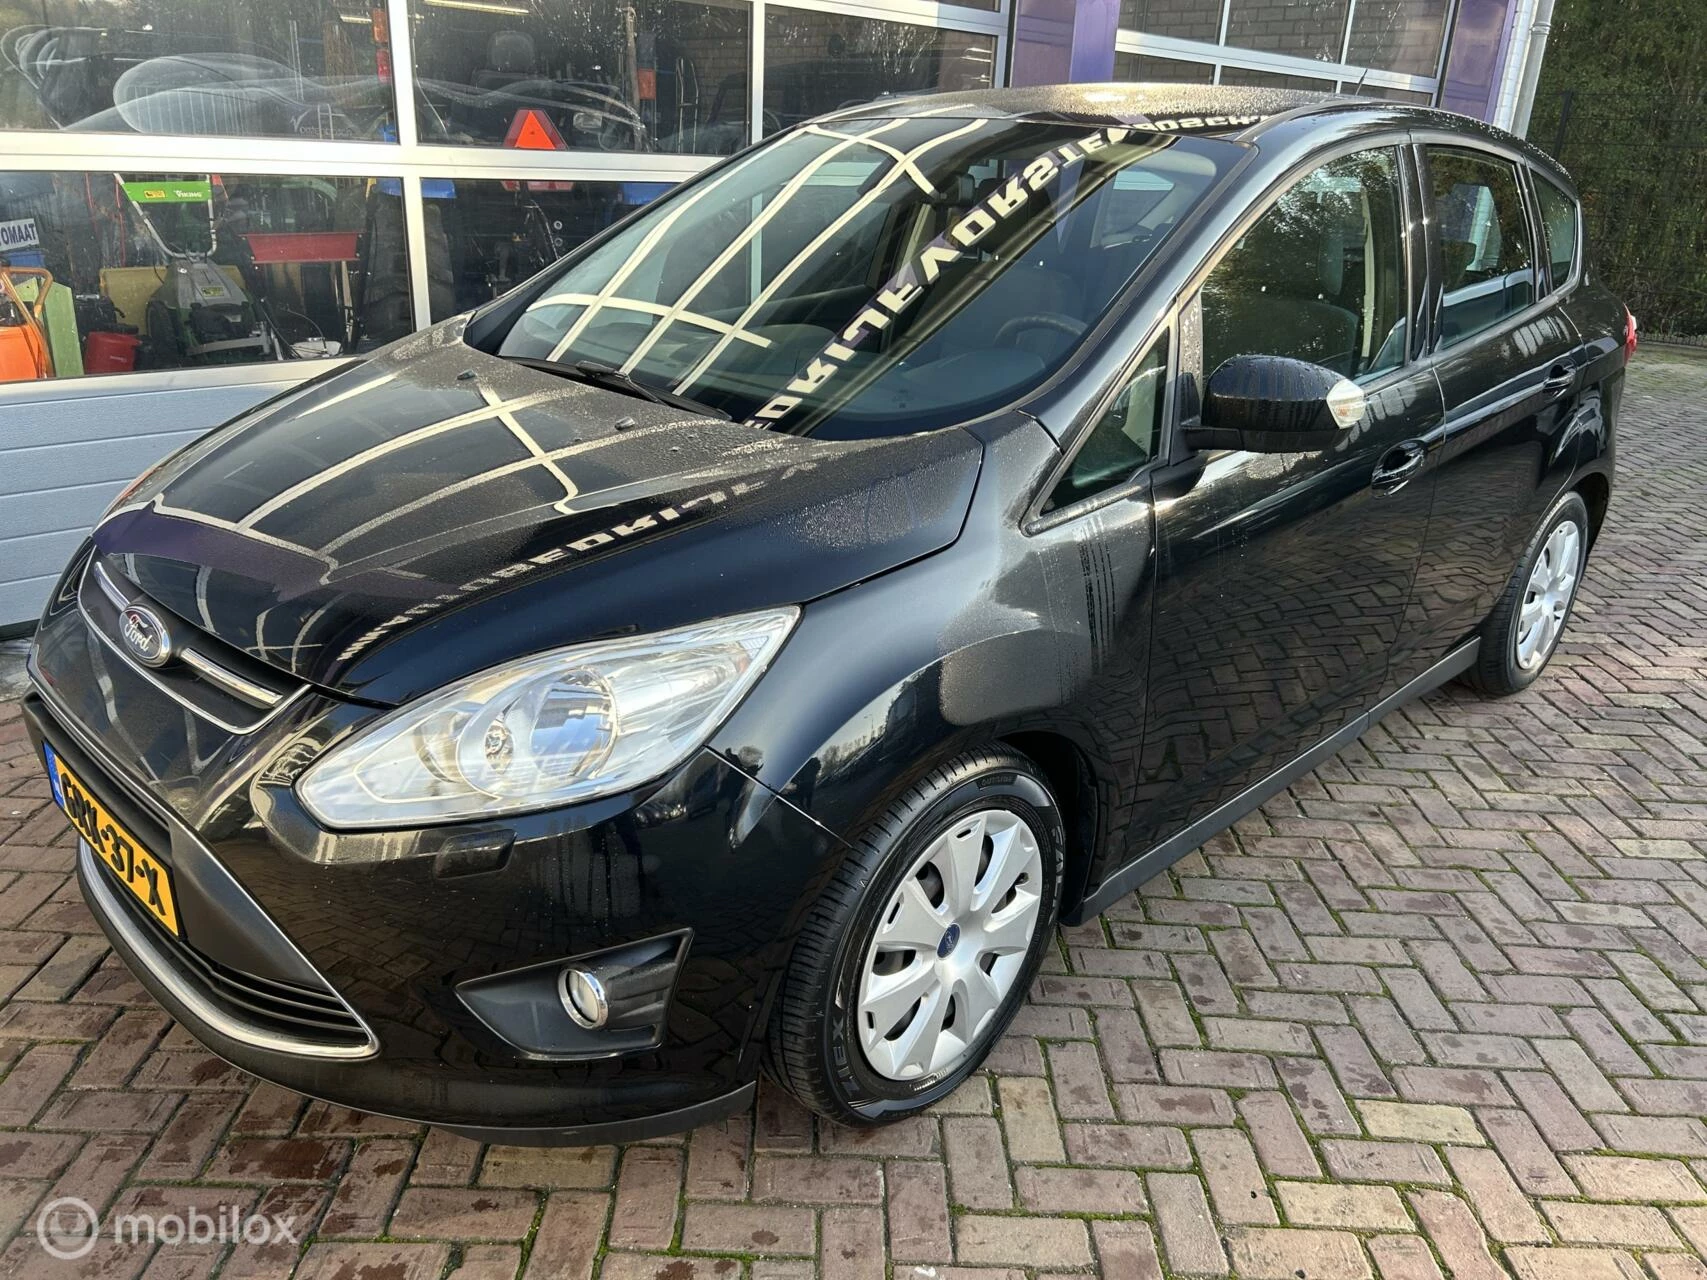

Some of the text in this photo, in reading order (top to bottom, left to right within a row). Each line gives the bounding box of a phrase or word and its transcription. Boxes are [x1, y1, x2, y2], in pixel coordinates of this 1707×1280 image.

[0, 223, 36, 246] OMAAT
[124, 614, 153, 652] Ford
[833, 1016, 860, 1094] ZIEX
